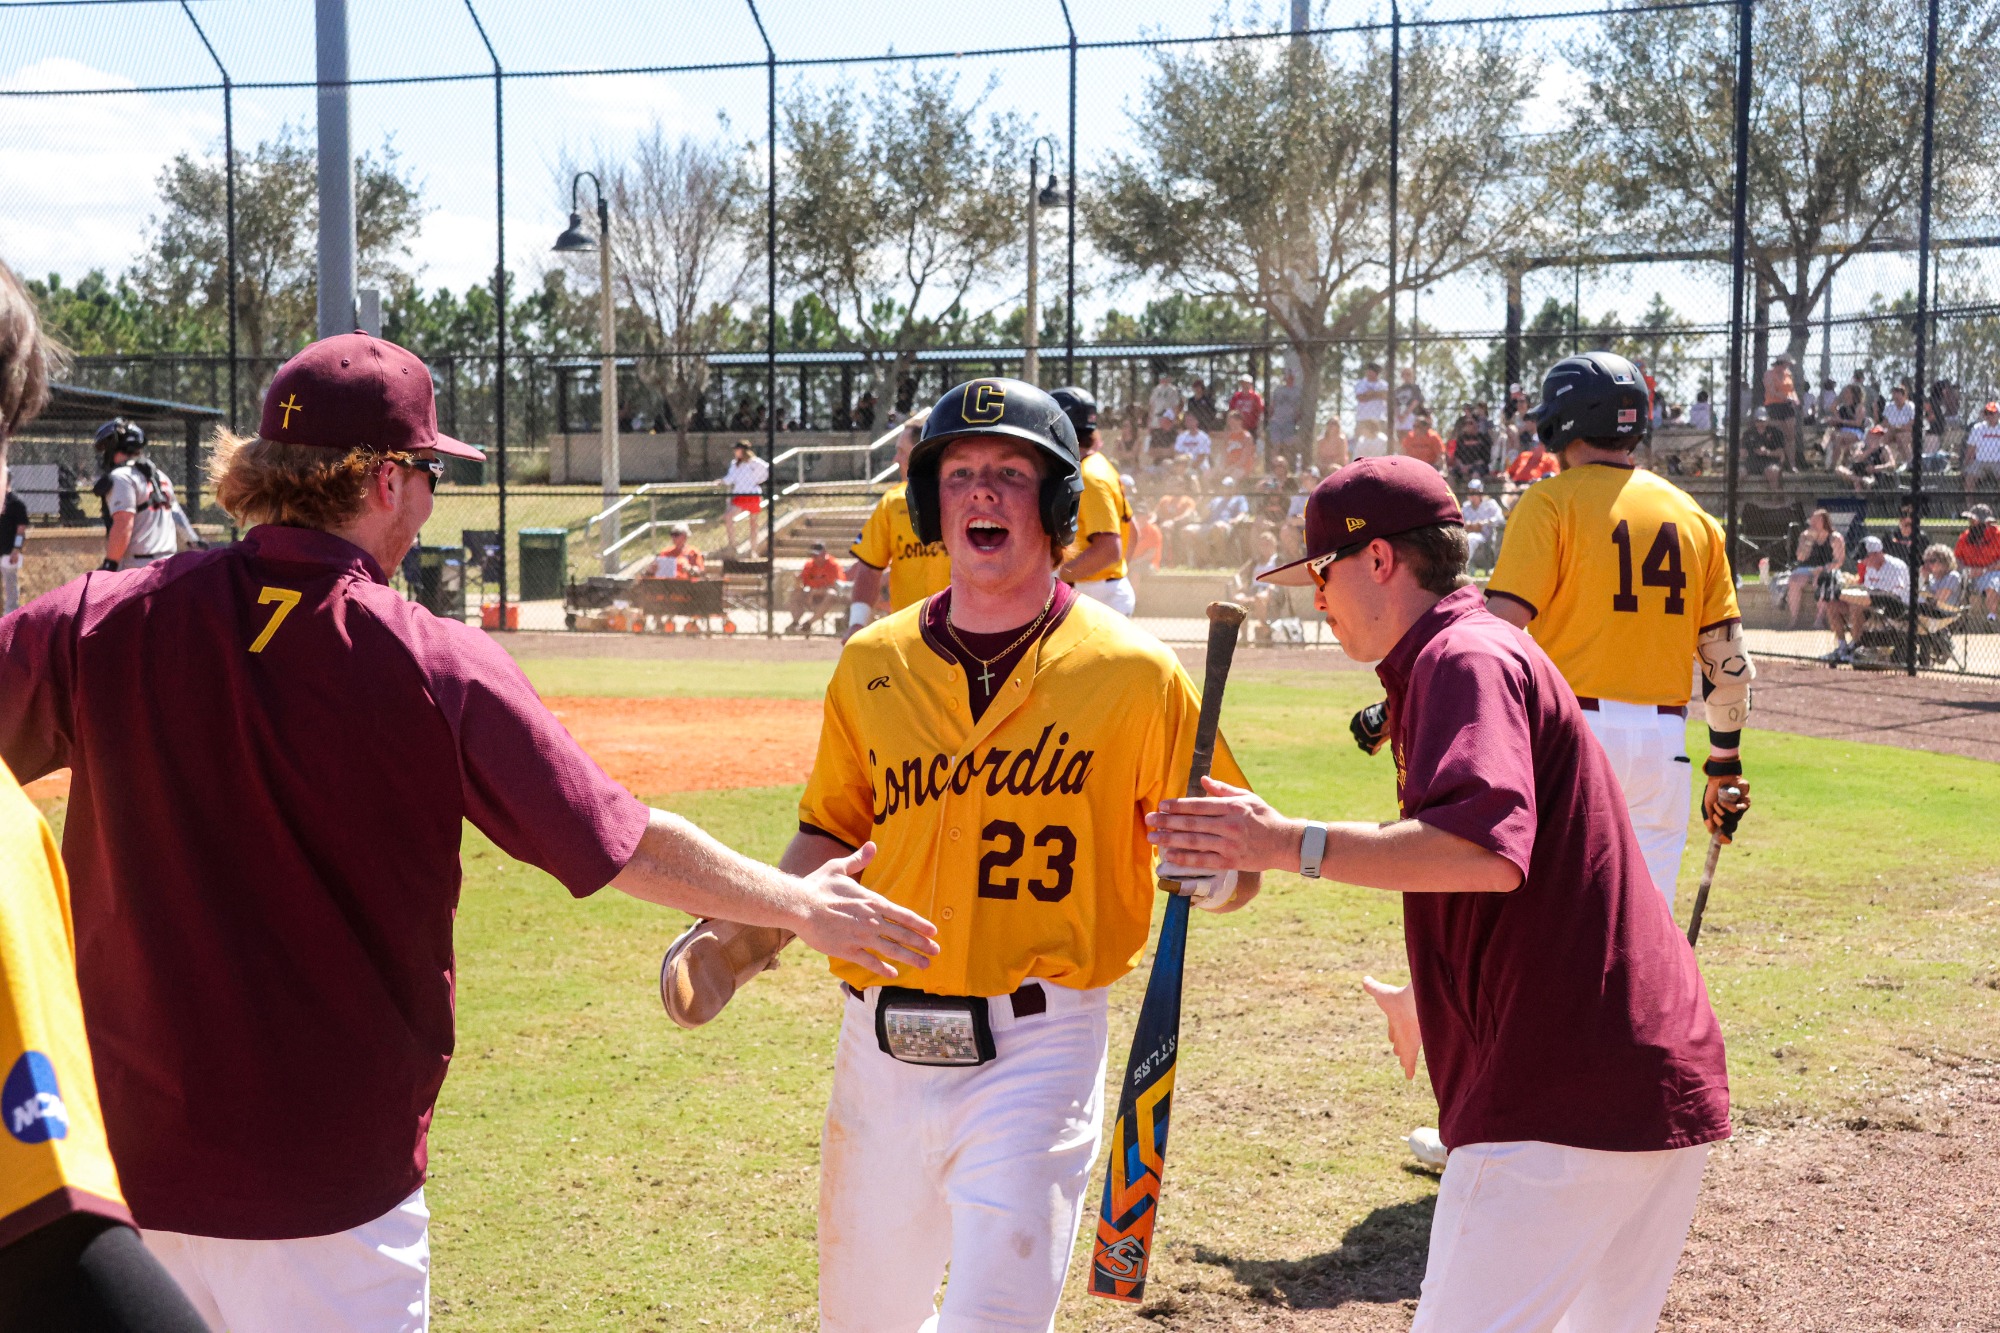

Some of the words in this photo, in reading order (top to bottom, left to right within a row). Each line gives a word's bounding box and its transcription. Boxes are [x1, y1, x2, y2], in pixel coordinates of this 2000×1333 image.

[962, 379, 1006, 424] C
[1612, 519, 1686, 615] 14
[248, 586, 302, 653] 7
[869, 721, 1095, 825] Concordia
[978, 819, 1077, 903] 23
[1133, 1034, 1176, 1086] ATLAS
